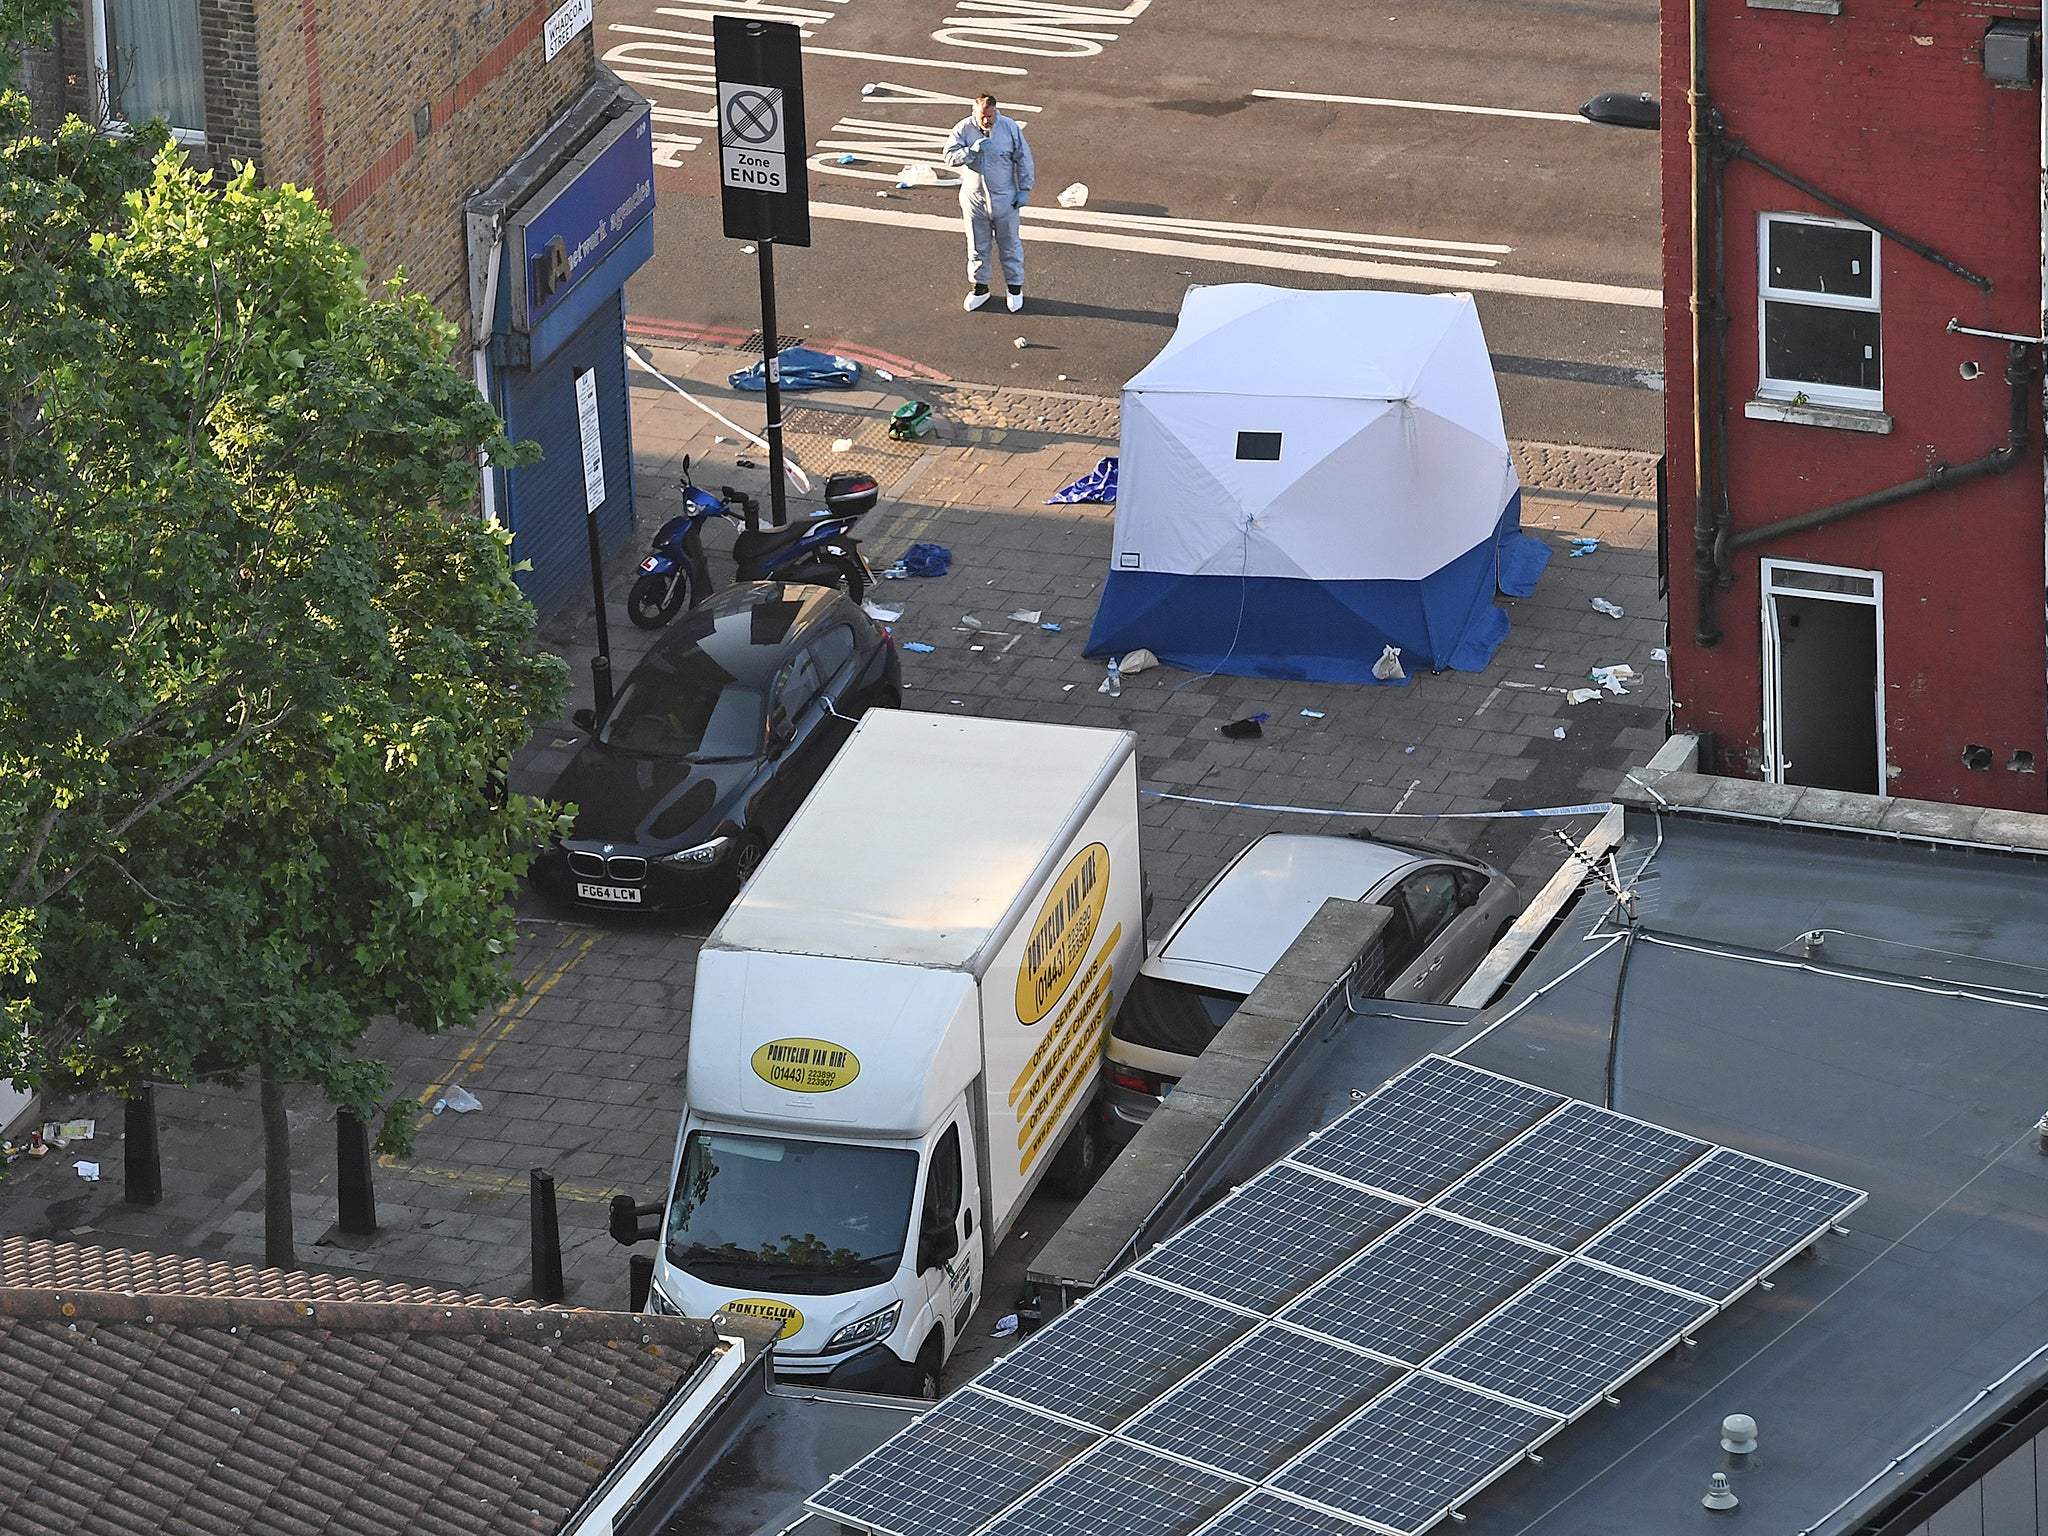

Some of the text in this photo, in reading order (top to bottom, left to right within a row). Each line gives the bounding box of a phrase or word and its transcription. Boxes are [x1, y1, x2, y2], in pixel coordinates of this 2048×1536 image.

[550, 23, 574, 56] STREET
[738, 153, 770, 168] Zone
[730, 167, 780, 187] ENDS
[568, 218, 608, 271] network
[609, 179, 651, 231] agencies
[642, 557, 653, 570] L
[582, 885, 636, 900] FG64 LCW
[1027, 850, 1097, 982] PONTYCLUN VAN HIRE
[1034, 941, 1066, 1014] (01443)
[1032, 960, 1098, 1067] OPEN SEVEN DAYS
[1029, 985, 1101, 1102] NO MILEAGE CHARGE
[767, 1044, 848, 1069] PONTYCLUN VAN HIRE
[770, 1064, 837, 1084] (01443) 223890
[806, 1077, 835, 1087] 223907
[1029, 1010, 1102, 1129] OPEN BANK HOLIDAYS
[728, 1302, 797, 1319] PONTYCLUN
